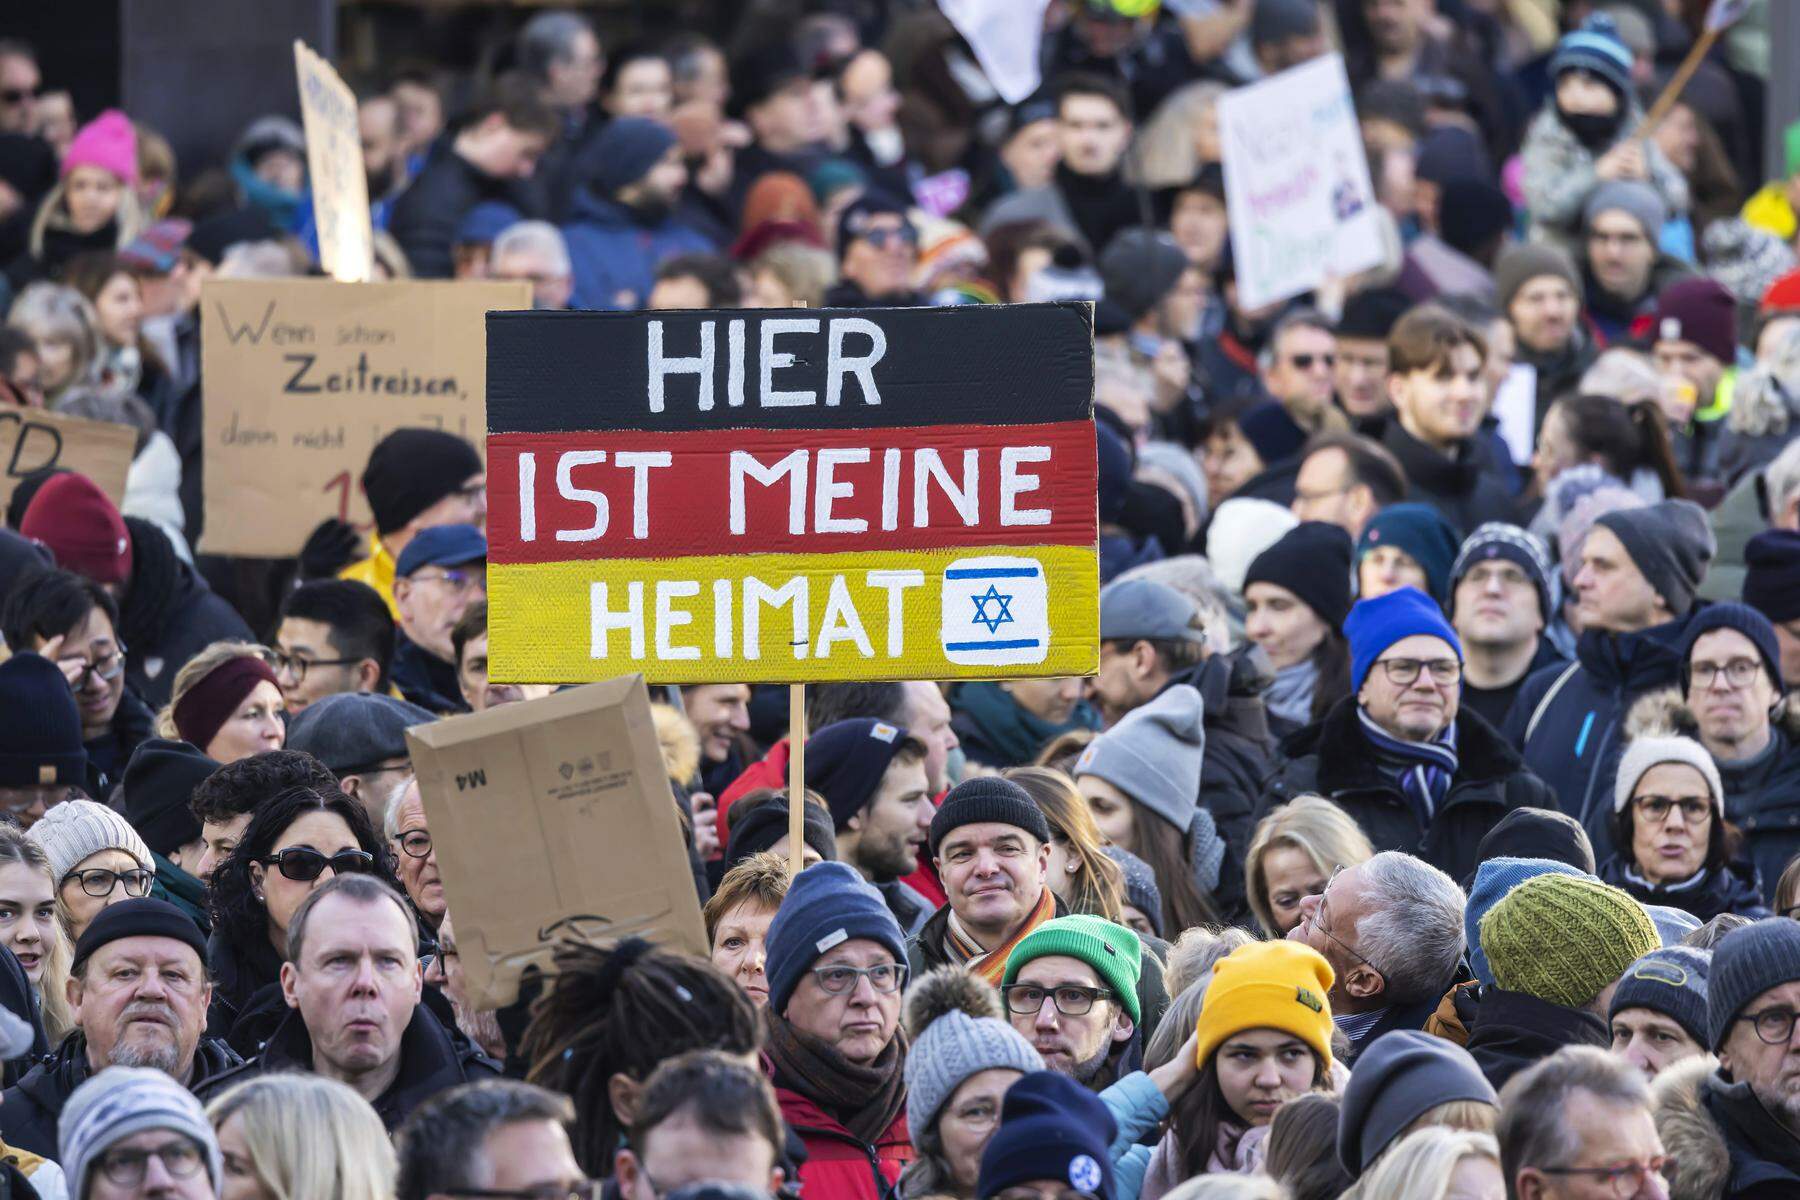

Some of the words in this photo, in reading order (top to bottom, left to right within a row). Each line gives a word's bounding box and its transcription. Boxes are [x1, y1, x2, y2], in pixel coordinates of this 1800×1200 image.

[283, 352, 468, 399] Zeitreisen,
[647, 317, 888, 413] HIER
[518, 449, 673, 543] IST
[729, 445, 1053, 536] MEINE
[589, 568, 926, 661] HEIMAT
[456, 769, 487, 792] M4
